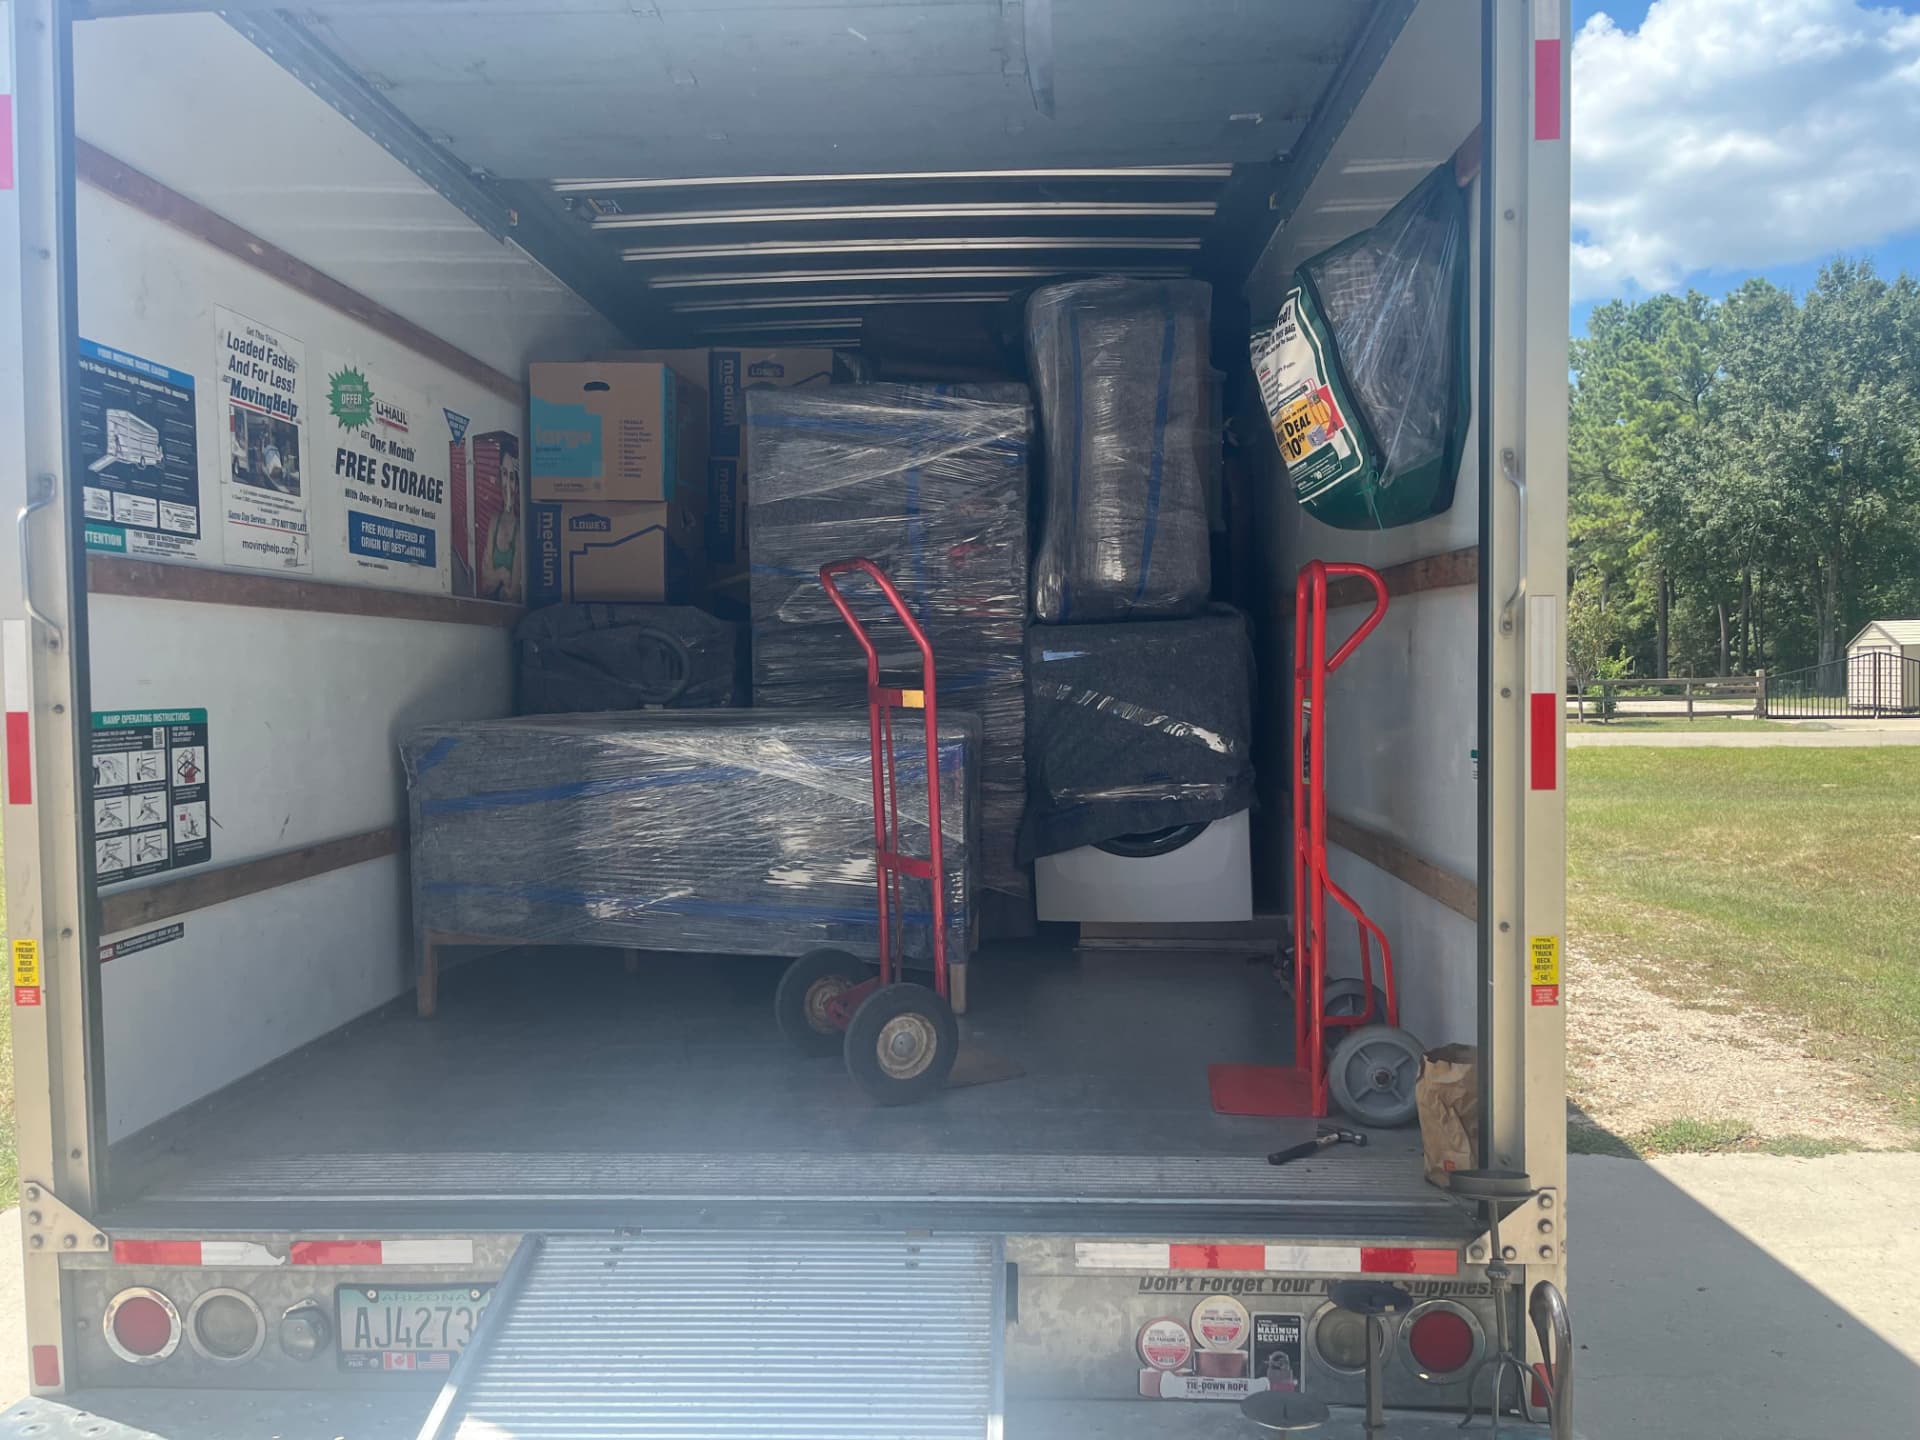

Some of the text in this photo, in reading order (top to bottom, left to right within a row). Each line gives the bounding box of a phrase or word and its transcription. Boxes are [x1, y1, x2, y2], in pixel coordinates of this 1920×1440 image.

[227, 331, 296, 374] Loaded Faster
[228, 354, 296, 394] And For Less!
[230, 377, 298, 422] MovingHelp
[341, 393, 362, 405] OFFER
[376, 401, 408, 426] U-HAUL
[1284, 412, 1312, 438] DEAL
[369, 433, 386, 453] One
[335, 447, 444, 504] FREE STORAGE
[359, 492, 383, 508] One-Way
[361, 522, 376, 535] FREE
[418, 535, 426, 545] AT
[573, 520, 607, 529] LOWE'S
[85, 531, 122, 547] TTENTION
[242, 540, 296, 555] movinghelp.com
[543, 512, 558, 586] medium
[1139, 1277, 1193, 1292] Don't
[1200, 1277, 1266, 1295] Forget
[1270, 1278, 1311, 1293] Your
[382, 1292, 467, 1303] ARIZONA
[355, 1306, 486, 1349] AJ4273
[1257, 1327, 1299, 1335] MAXIMUM
[1257, 1335, 1299, 1343] SECURITY
[1186, 1382, 1249, 1392] TIE-DOWN ROPE
